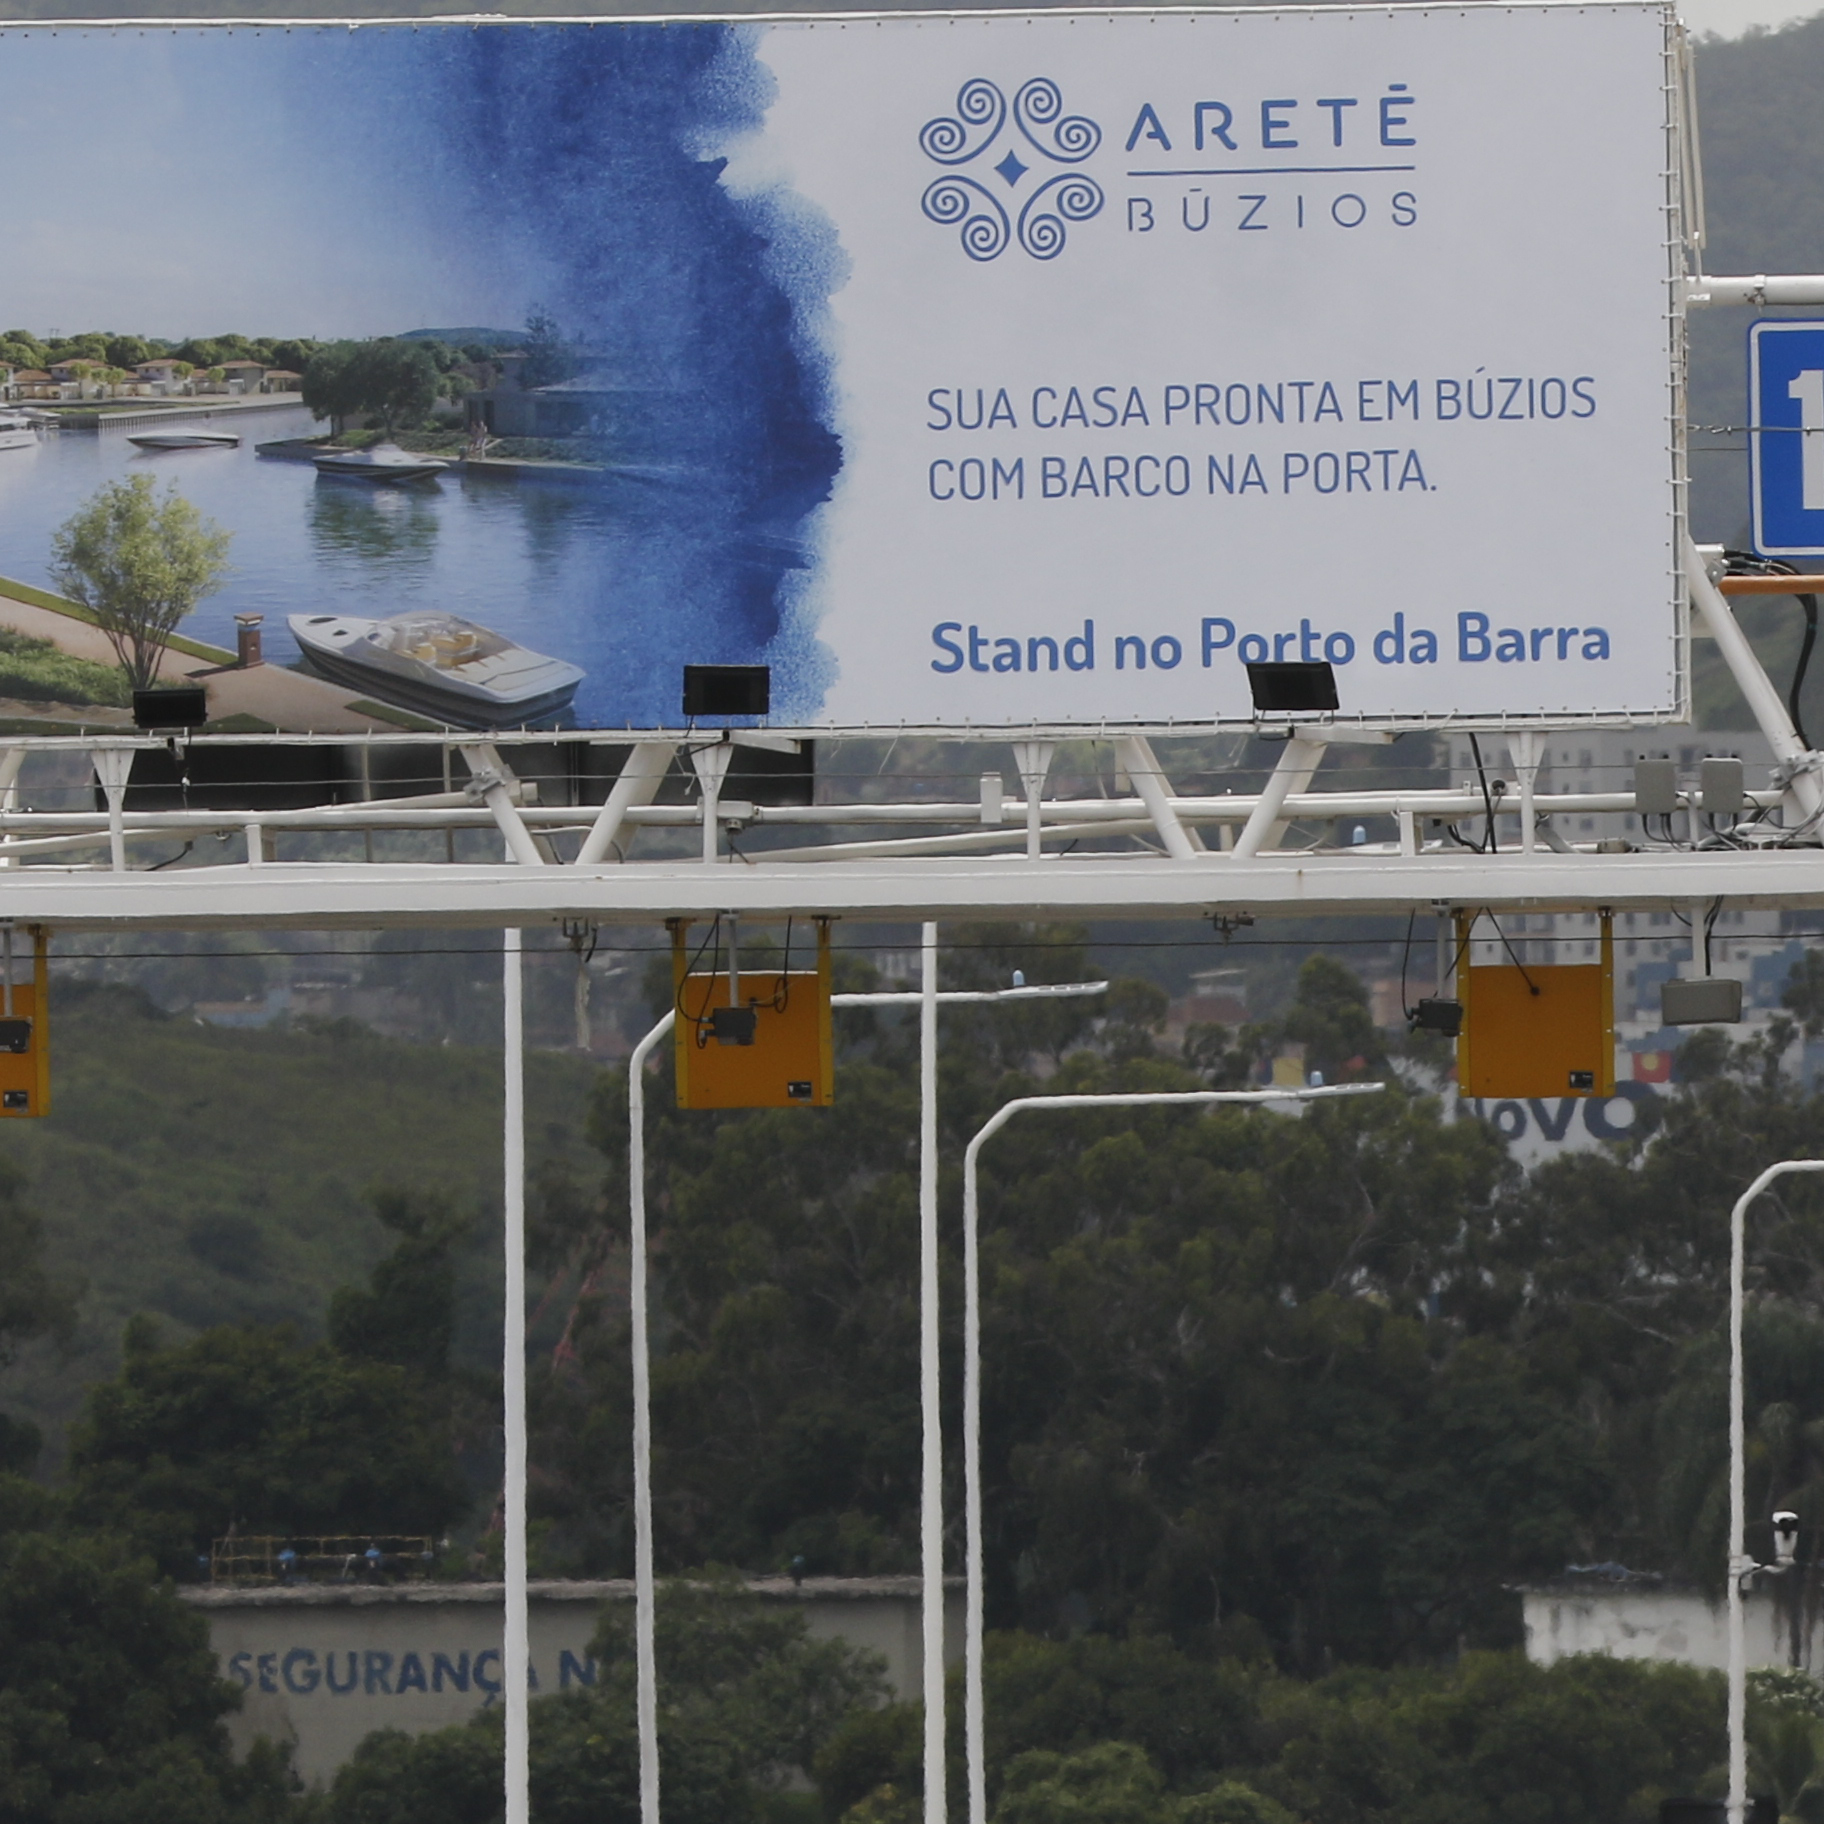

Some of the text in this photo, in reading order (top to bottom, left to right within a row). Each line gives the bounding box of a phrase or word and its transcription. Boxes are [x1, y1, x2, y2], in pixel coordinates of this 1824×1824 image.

[927, 367, 1596, 431] SUA CASA PRONTA EM BÚZIOS
[928, 449, 1437, 501] COM BARCO NA PORTA.
[930, 611, 1611, 673] Stand no Porto da Barra
[229, 1647, 538, 1706] SEGURANÇ
